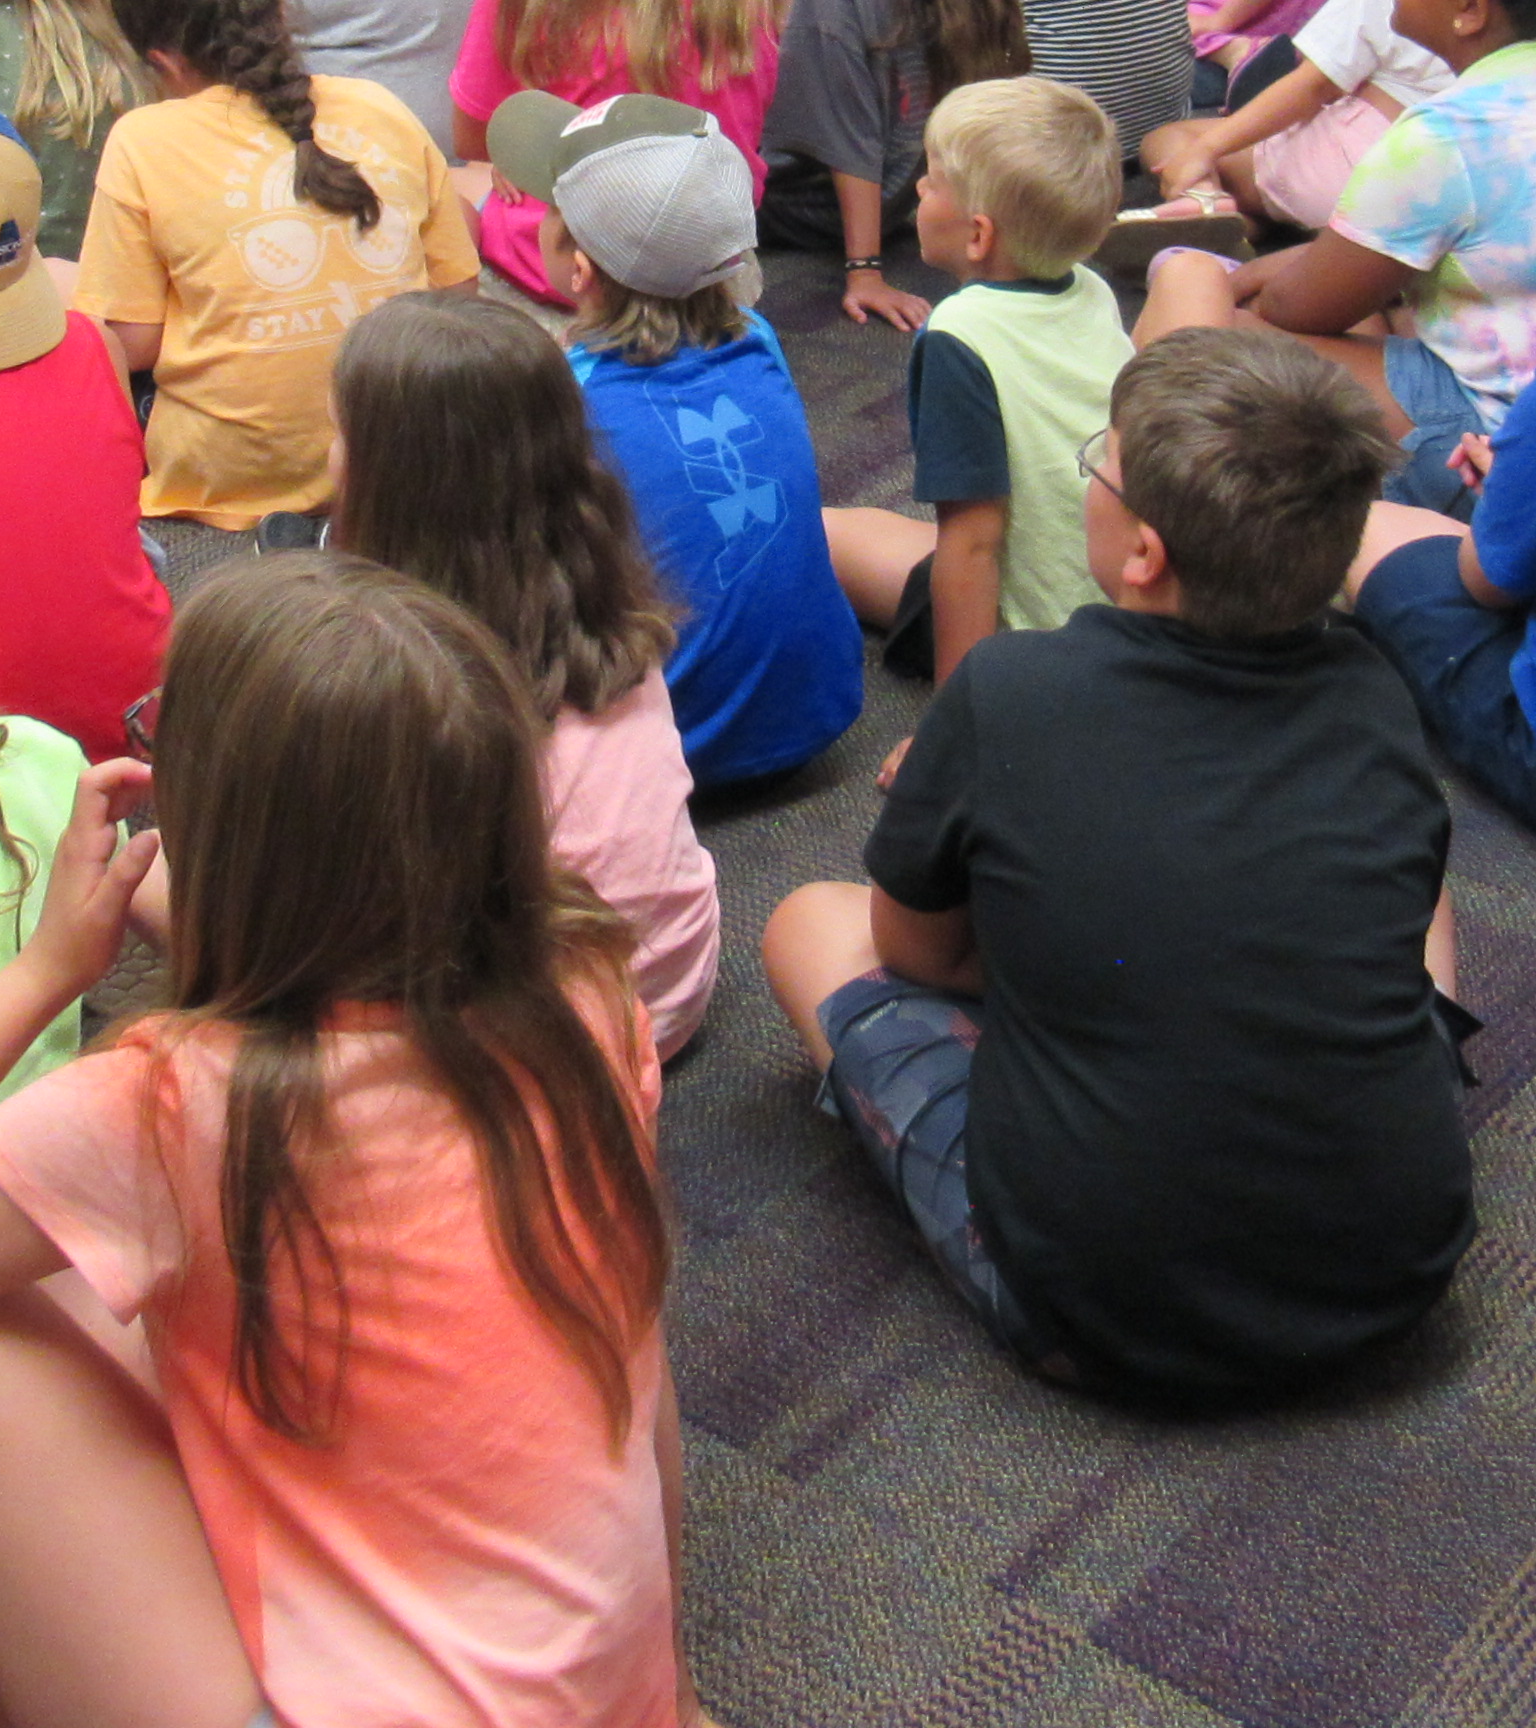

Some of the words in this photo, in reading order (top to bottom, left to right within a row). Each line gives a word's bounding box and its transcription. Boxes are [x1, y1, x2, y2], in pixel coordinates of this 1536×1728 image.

[223, 130, 275, 210] STAY
[315, 121, 401, 187] UNNY
[248, 306, 327, 341] STAY
